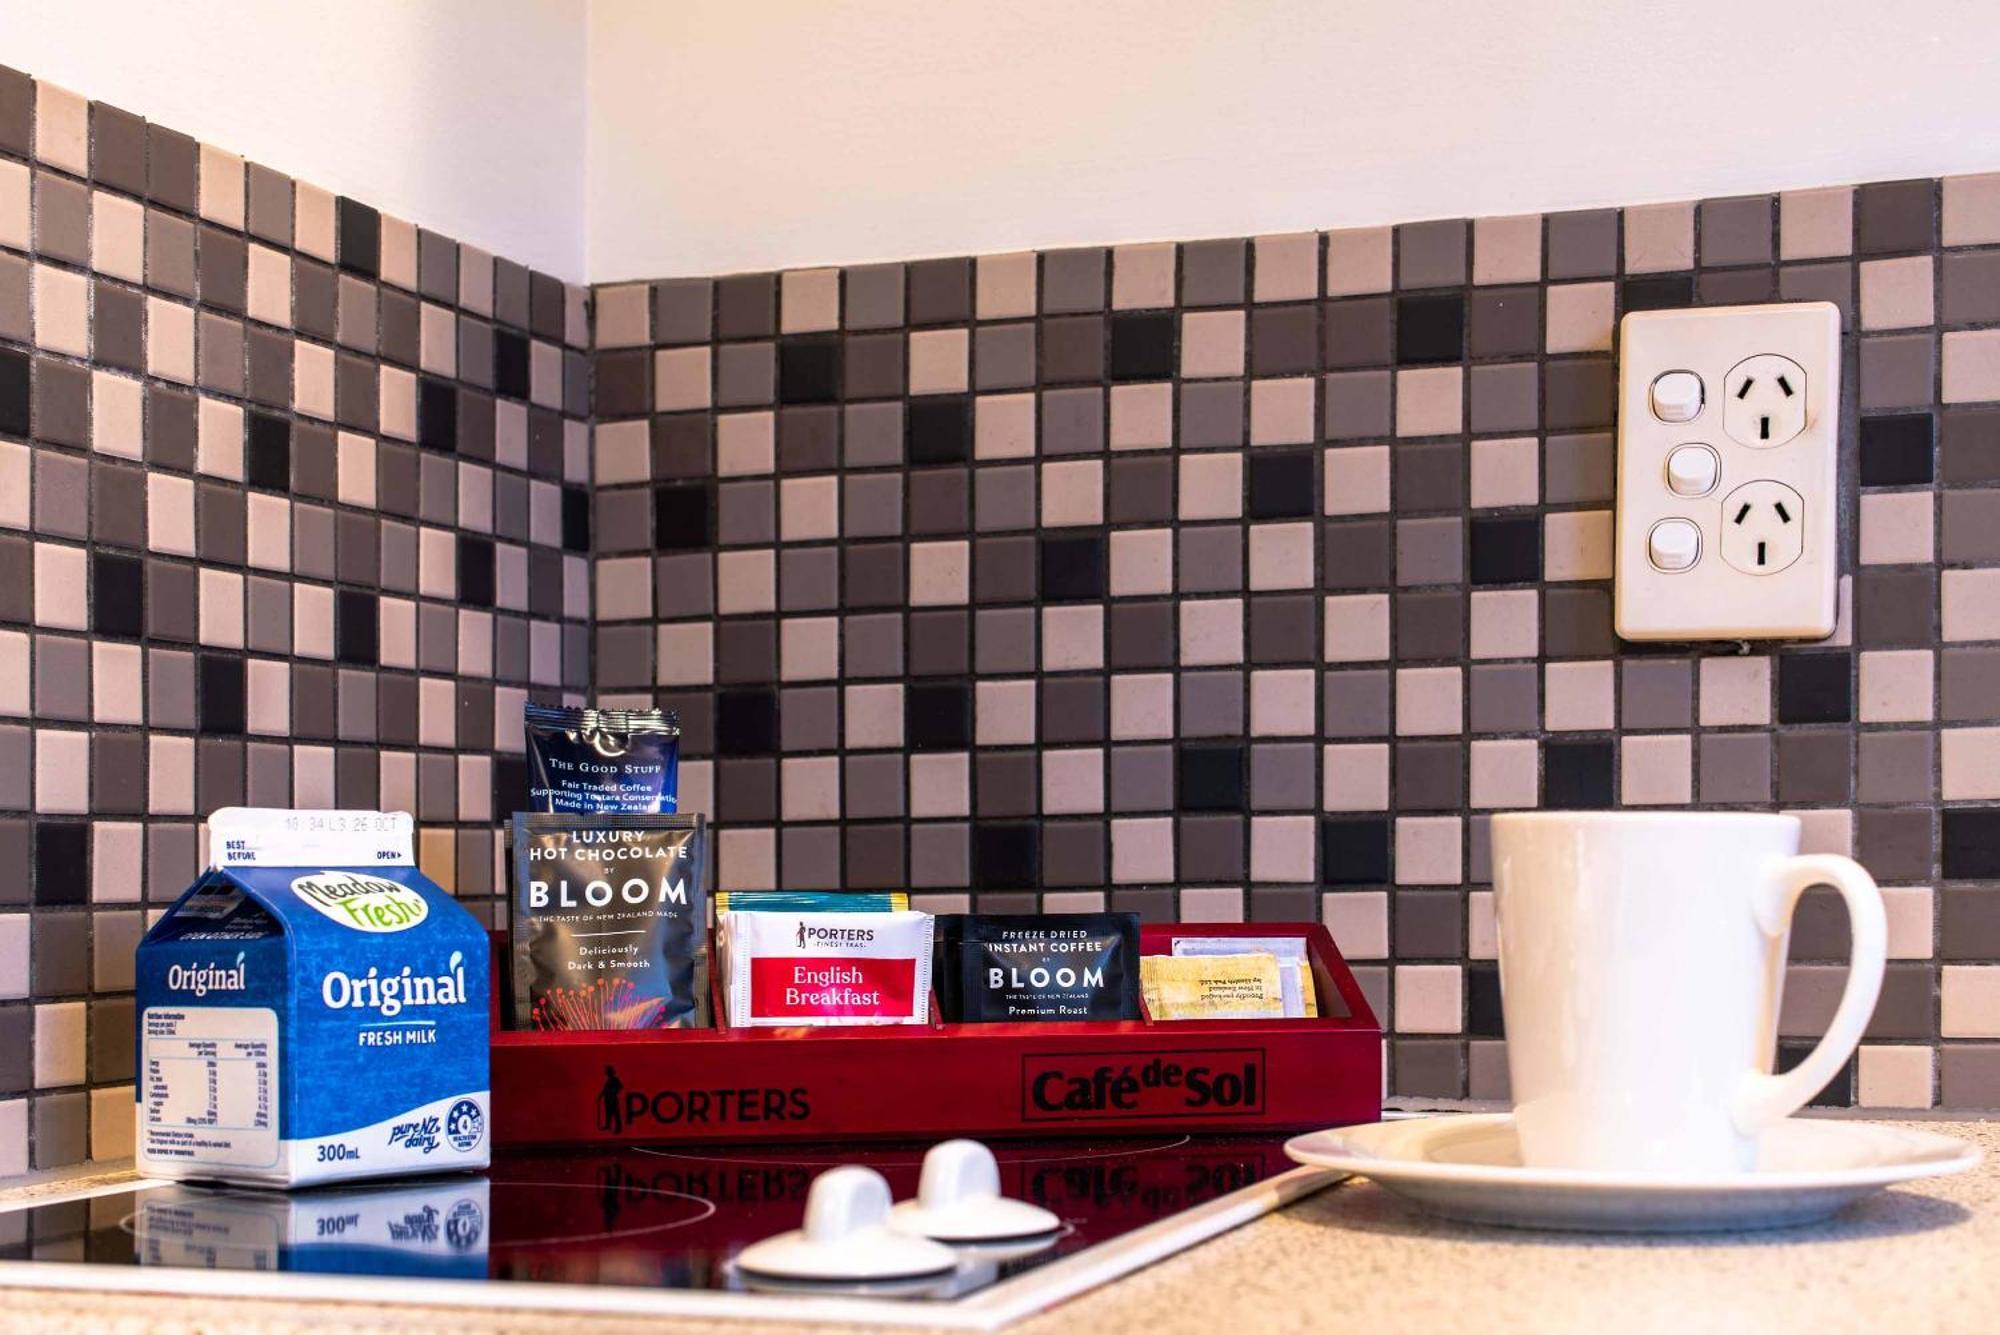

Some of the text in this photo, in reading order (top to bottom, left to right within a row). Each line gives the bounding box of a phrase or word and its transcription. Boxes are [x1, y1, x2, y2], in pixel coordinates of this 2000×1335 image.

[530, 787, 583, 800] Supporting
[561, 780, 652, 792] Fair Traded Coffee
[555, 798, 581, 809] Made
[584, 802, 594, 810] in
[597, 802, 618, 811] New
[572, 830, 645, 843] LUXURY
[226, 840, 246, 850] BEST
[227, 852, 256, 861] BEFORE
[377, 852, 396, 860] OPEN
[530, 846, 687, 861] HOT CHOCOLATE
[298, 876, 401, 907] Meadow
[530, 877, 687, 908] BLOOM
[335, 895, 418, 928] Fresh
[808, 927, 874, 941] PORTERS
[1002, 930, 1087, 939] FREEZE DRIED
[579, 944, 639, 956] Deliciously
[988, 942, 1103, 953] INSTANT COFFEE
[568, 960, 650, 971] Dark & Smooth
[168, 957, 245, 997] Original
[793, 966, 863, 985] English
[989, 967, 1104, 989] BLOOM
[322, 963, 467, 1017] Original
[785, 987, 880, 1006] Breakfast
[1008, 1005, 1088, 1015] Premium Roast
[359, 1029, 436, 1046] FRESH MILK
[1032, 1058, 1256, 1111] Café de Sol
[625, 1088, 812, 1125] PORTERS
[404, 1133, 440, 1154] dairy
[317, 1143, 360, 1162] 300mL
